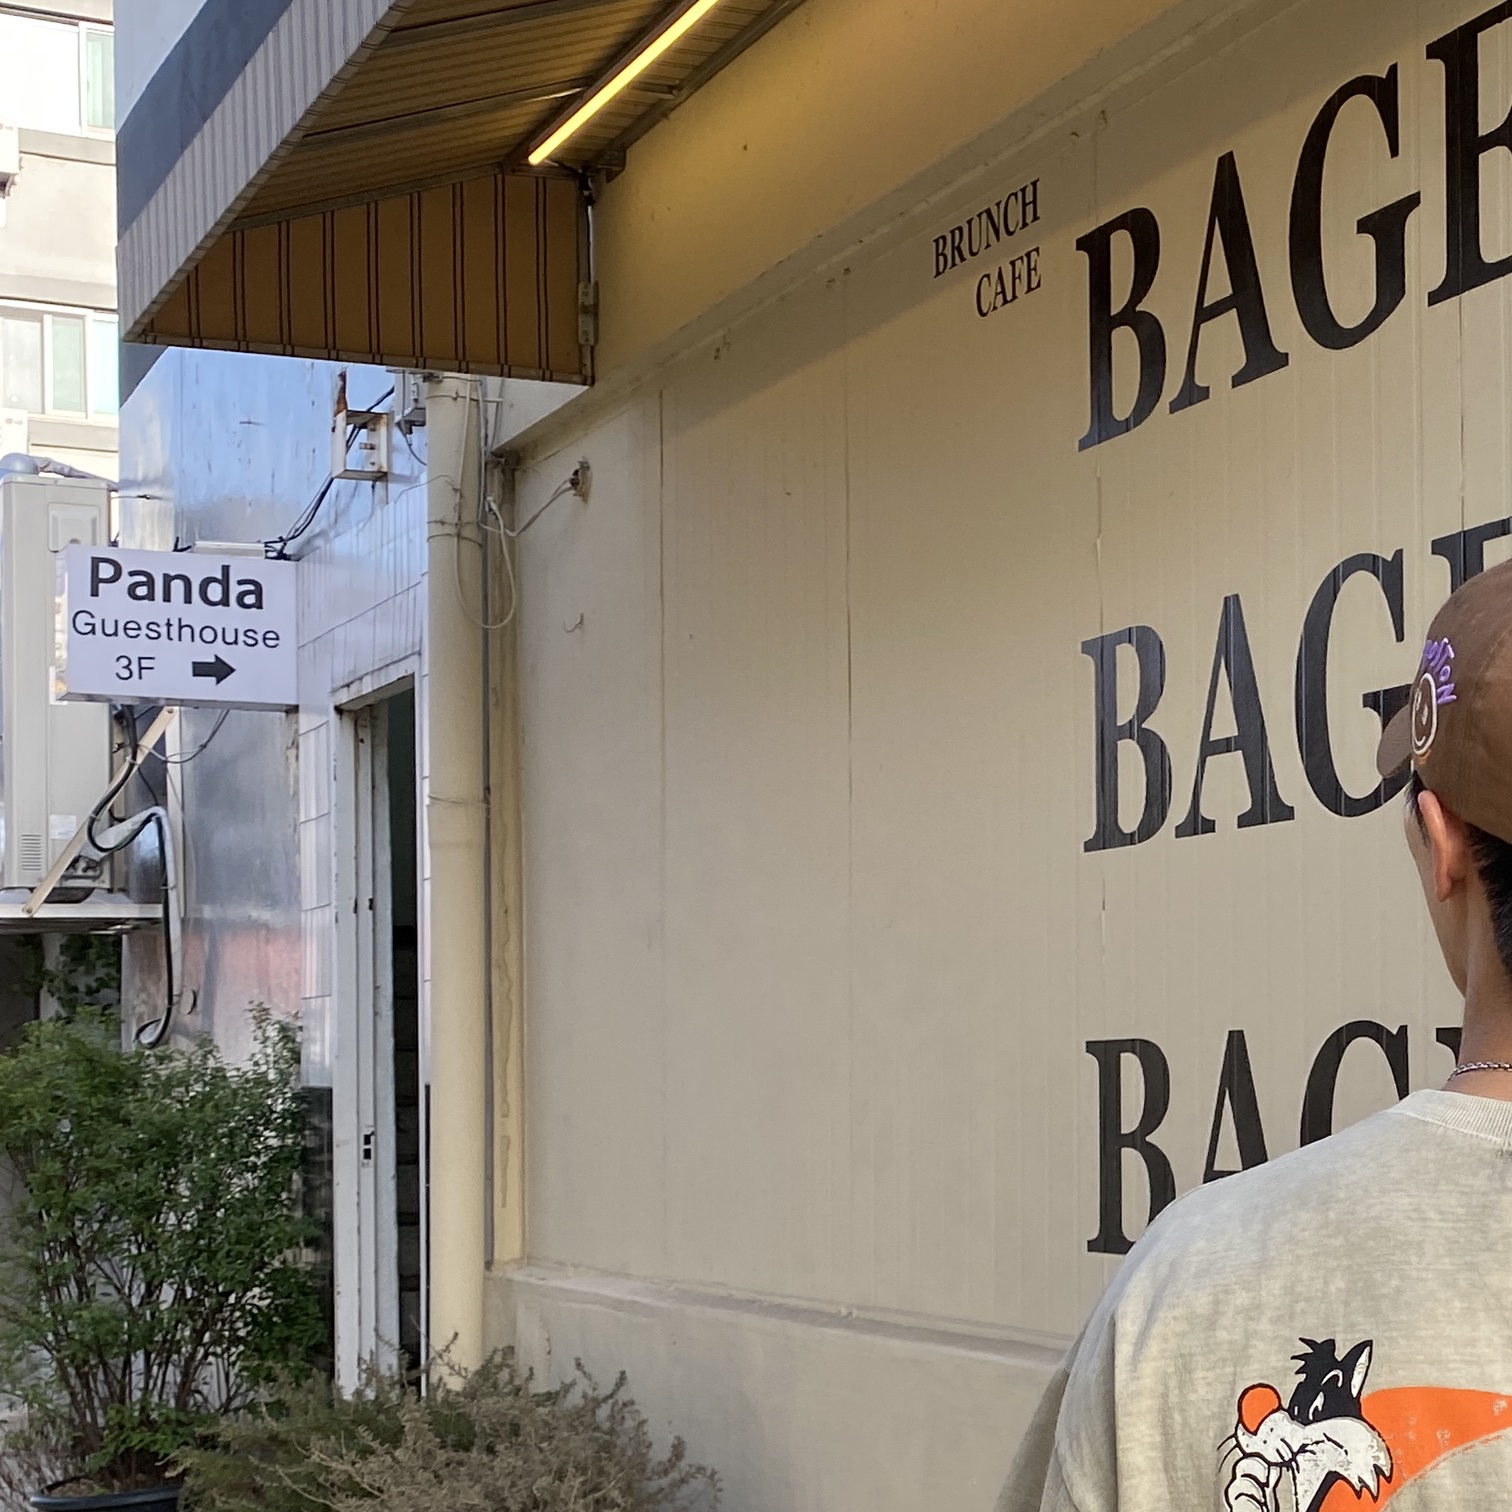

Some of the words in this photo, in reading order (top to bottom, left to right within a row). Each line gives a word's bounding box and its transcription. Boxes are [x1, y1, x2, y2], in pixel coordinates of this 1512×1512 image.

[932, 177, 1041, 279] BRUNCH
[975, 246, 1042, 318] CAFE
[89, 556, 264, 610] Panda
[71, 609, 281, 649] Guesthouse
[114, 654, 156, 681] 3F
